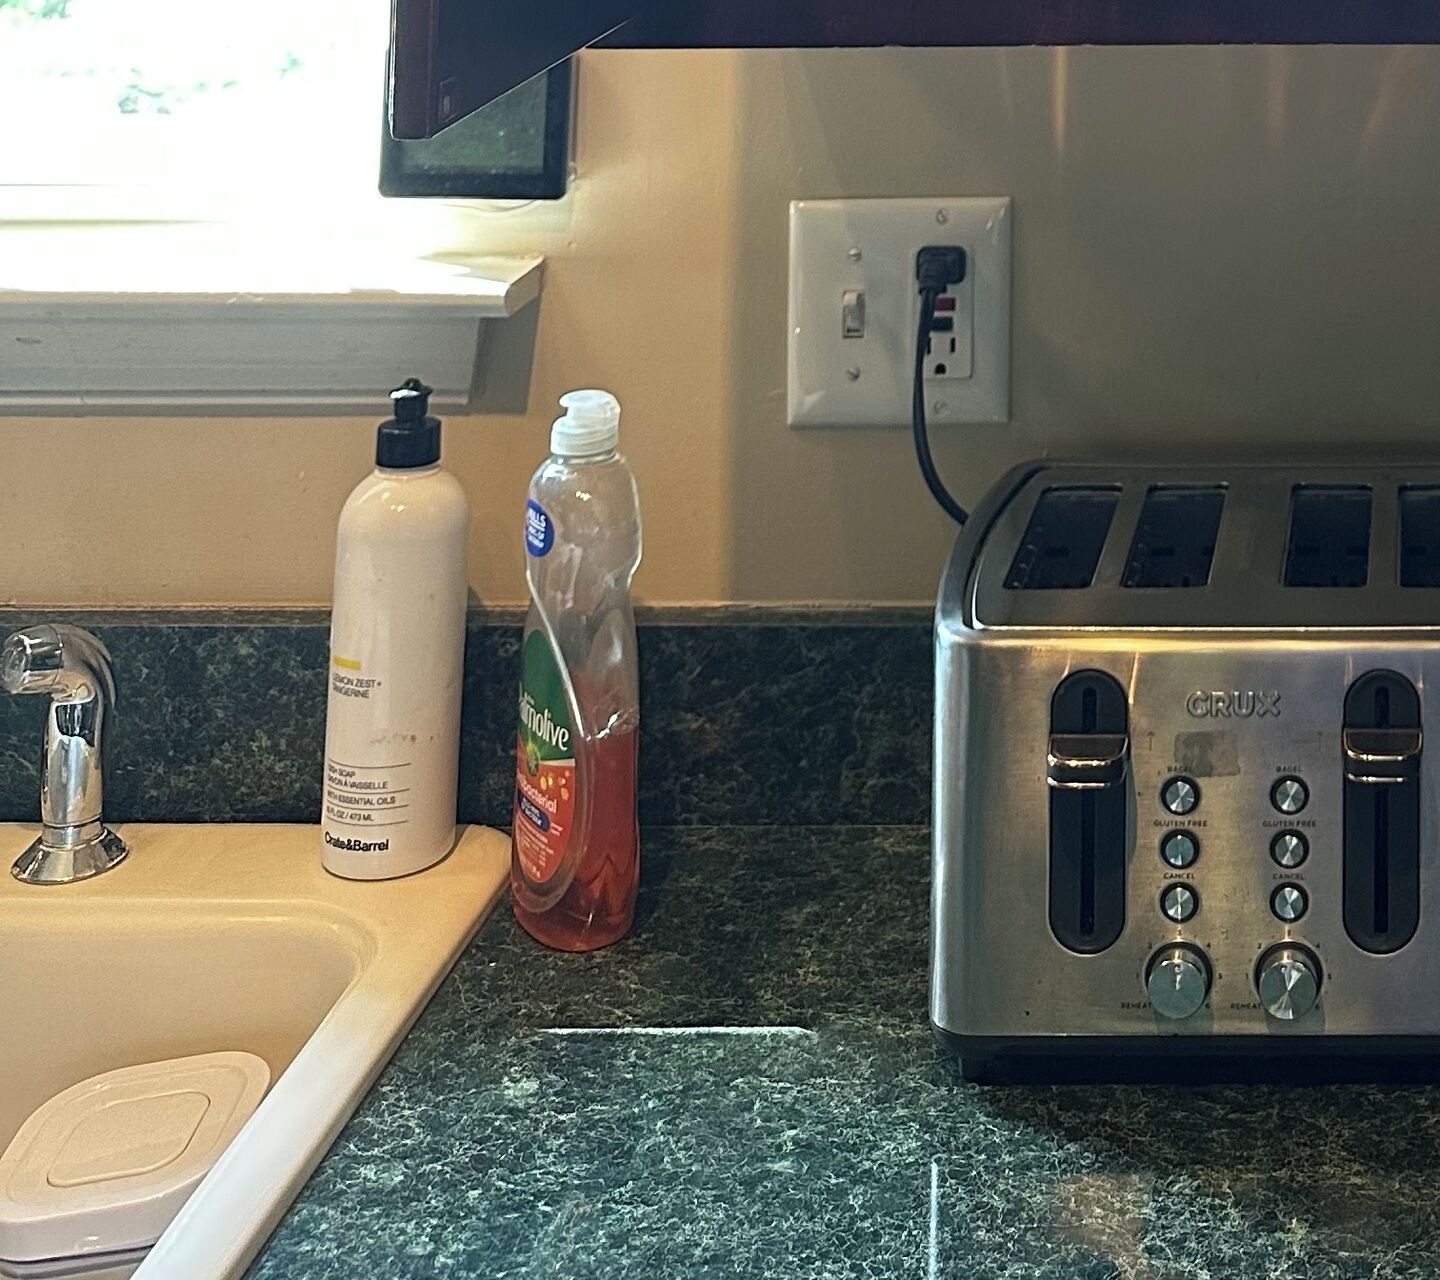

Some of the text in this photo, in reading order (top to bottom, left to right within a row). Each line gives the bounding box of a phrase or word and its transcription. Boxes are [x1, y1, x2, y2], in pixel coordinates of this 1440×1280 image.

[355, 678, 376, 689] ZEST
[1186, 690, 1281, 718] CRUX
[520, 691, 570, 752] lmolive
[377, 796, 396, 805] OILS
[325, 831, 390, 852] Crate&Barrel
[1163, 872, 1196, 880] CANCEL
[1272, 872, 1306, 880] CANCEL
